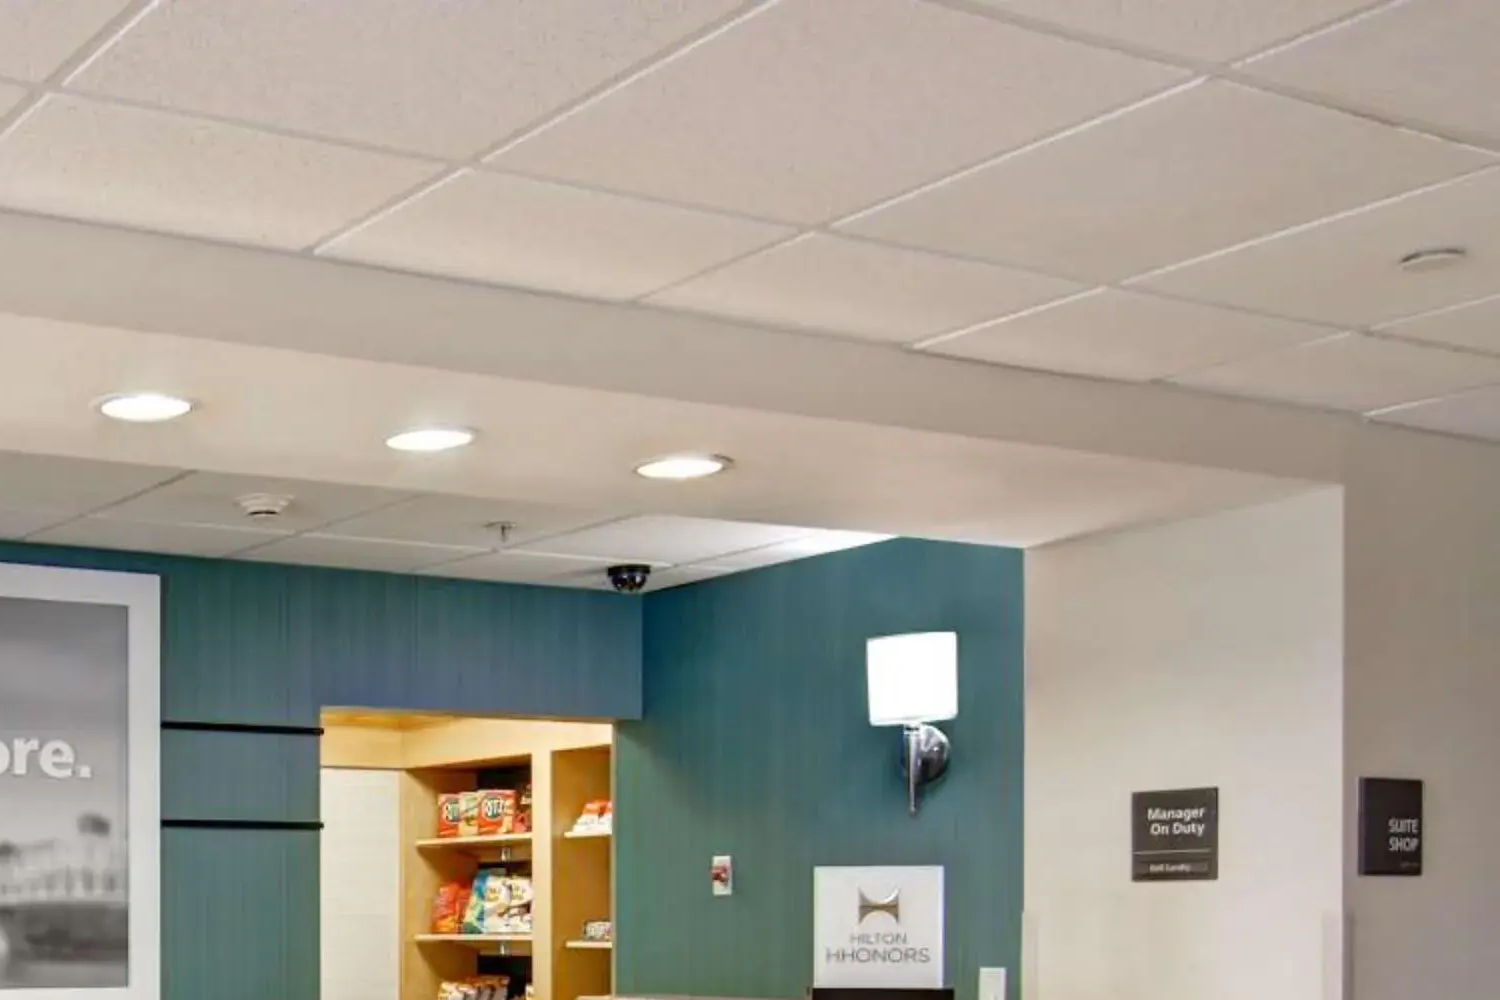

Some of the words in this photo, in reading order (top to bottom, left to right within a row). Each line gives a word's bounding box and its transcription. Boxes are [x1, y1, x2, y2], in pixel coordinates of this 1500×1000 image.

[1147, 807, 1205, 821] Manager
[1149, 822, 1170, 836] On
[1172, 821, 1205, 837] Duty
[1388, 818, 1420, 833] SUITE
[1388, 837, 1420, 852] SHOP
[850, 933, 908, 945] HILTON
[825, 947, 931, 964] HHONORS
